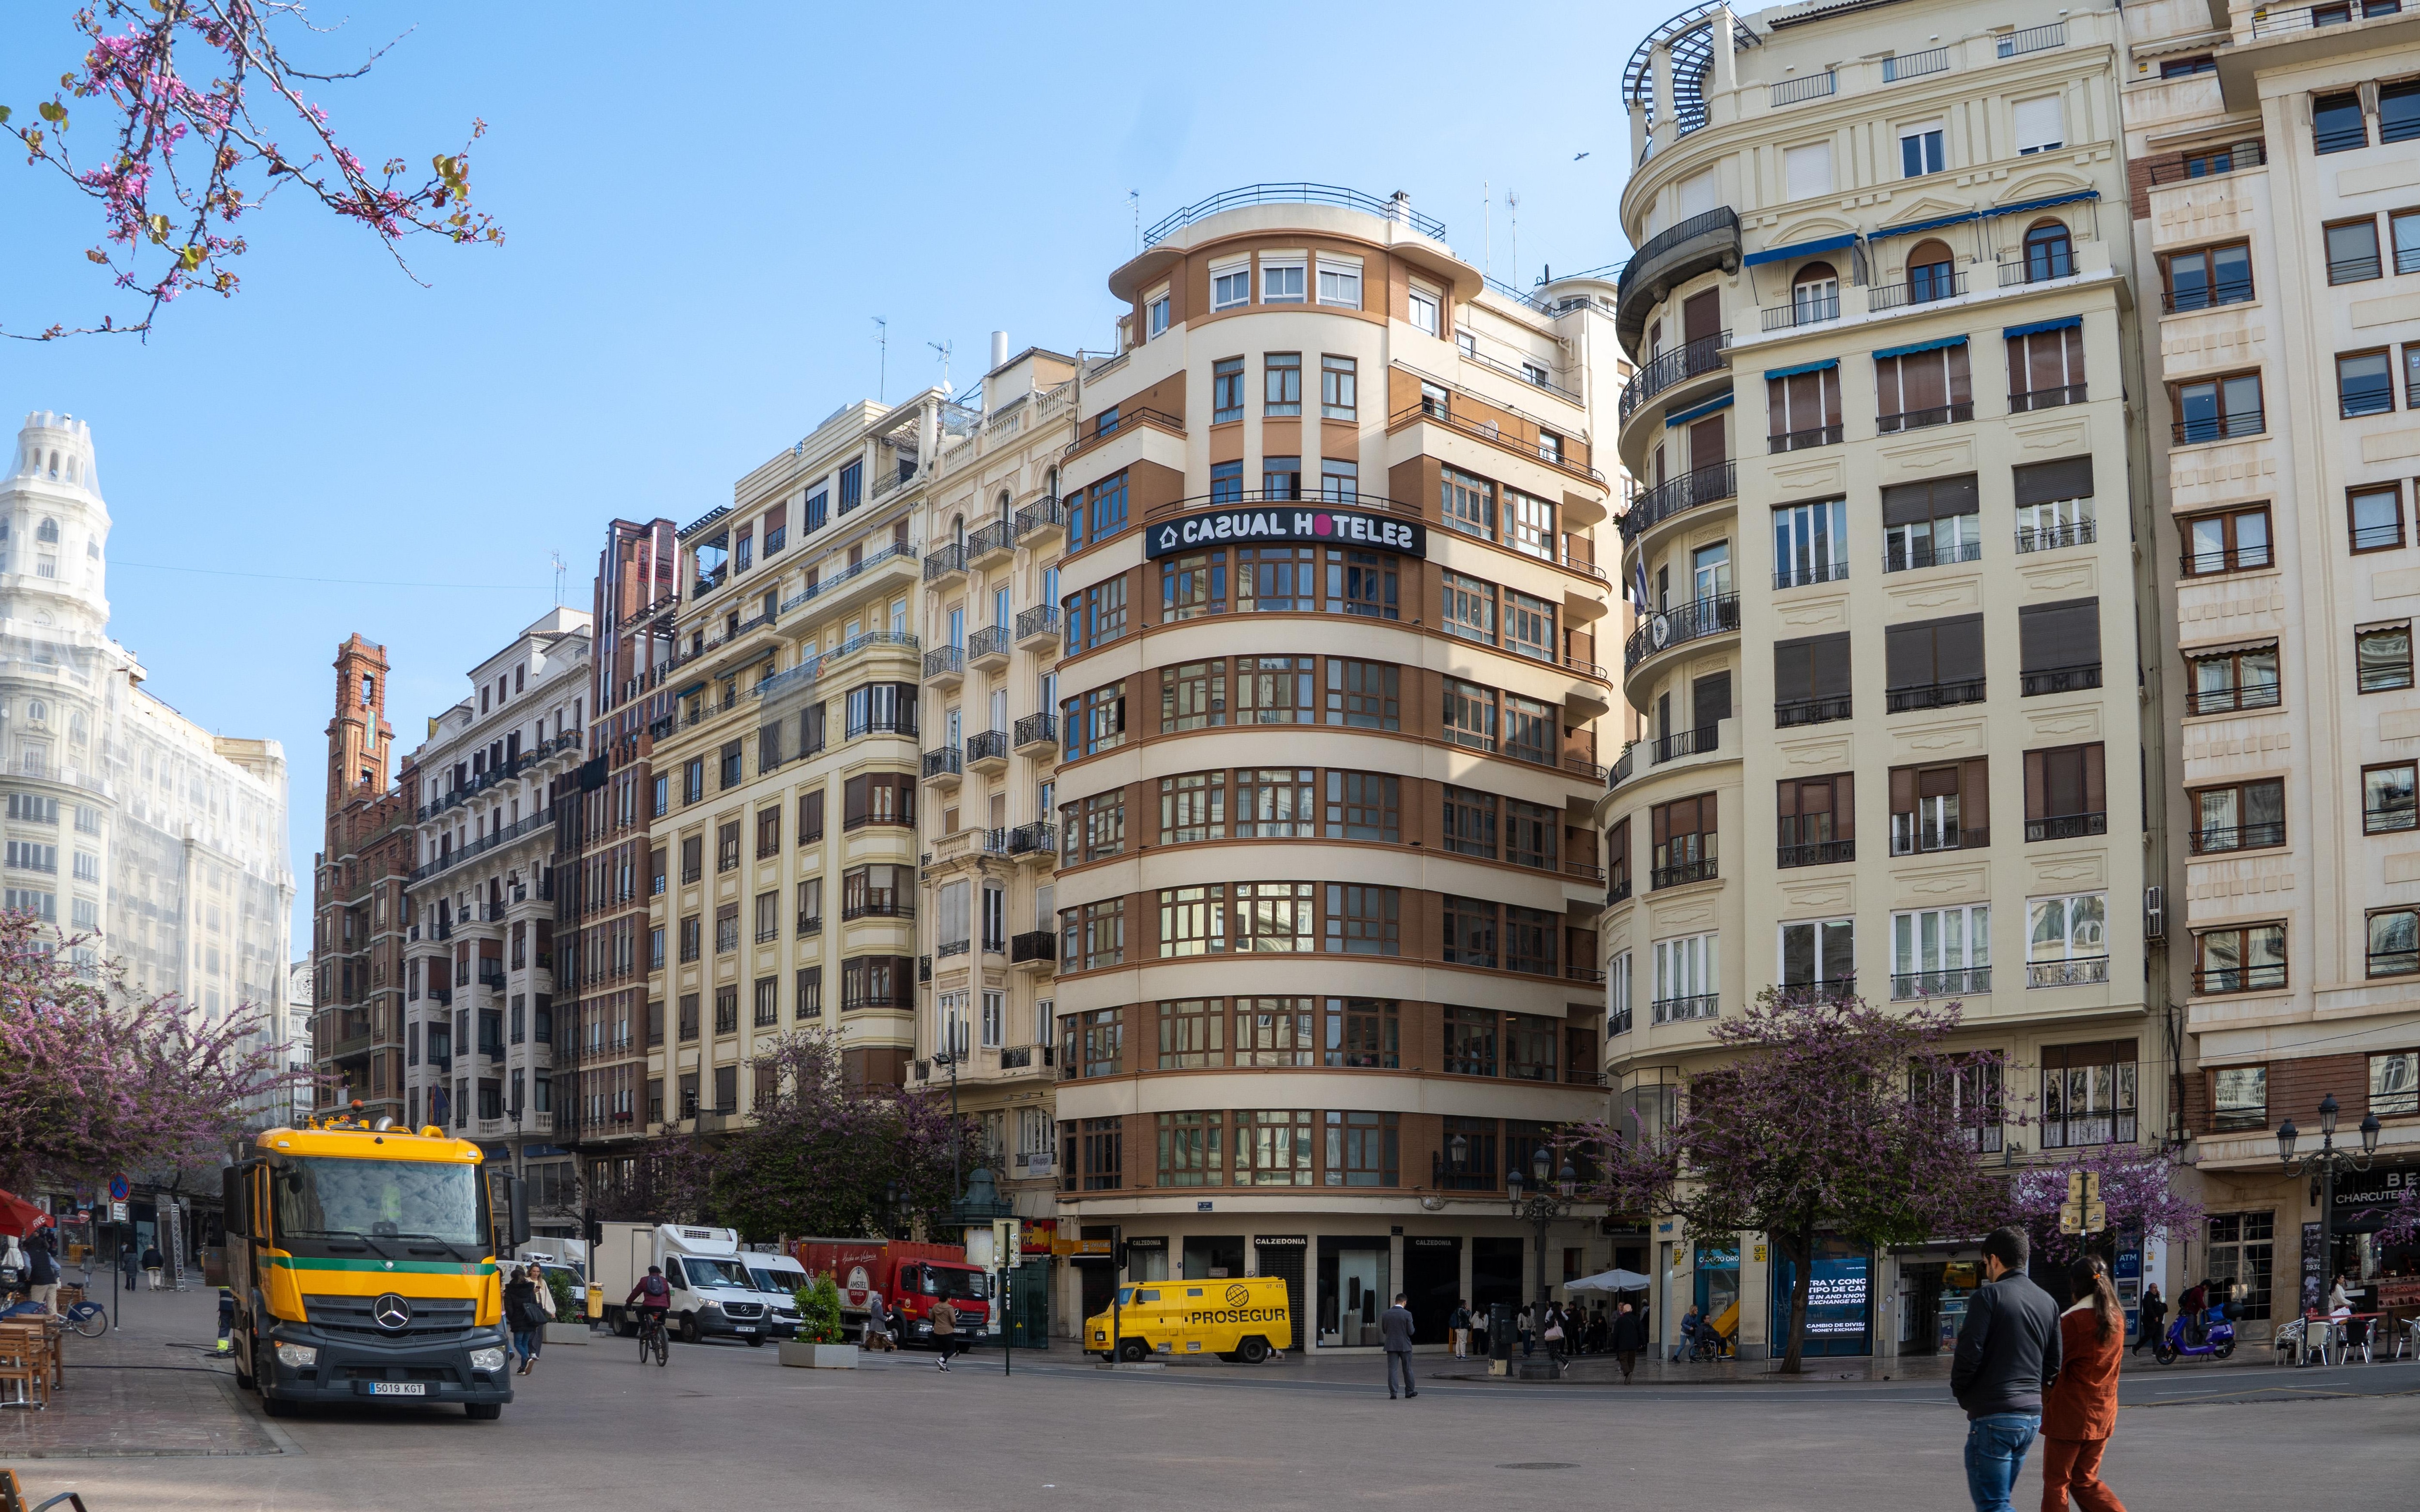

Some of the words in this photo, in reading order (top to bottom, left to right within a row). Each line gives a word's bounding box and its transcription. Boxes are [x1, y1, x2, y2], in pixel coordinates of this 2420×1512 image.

[1183, 512, 1286, 543] CASUAL
[1294, 513, 1412, 548] HOTELES
[1033, 1157, 1048, 1166] Hupp
[2388, 1172, 2417, 1187] BE
[842, 1251, 854, 1265] Hecha
[860, 1250, 877, 1262] Valencia
[461, 1264, 476, 1275] 33
[1192, 1308, 1286, 1324] PROSEGUR
[376, 1384, 400, 1392] 5019
[405, 1384, 422, 1393] KGT
